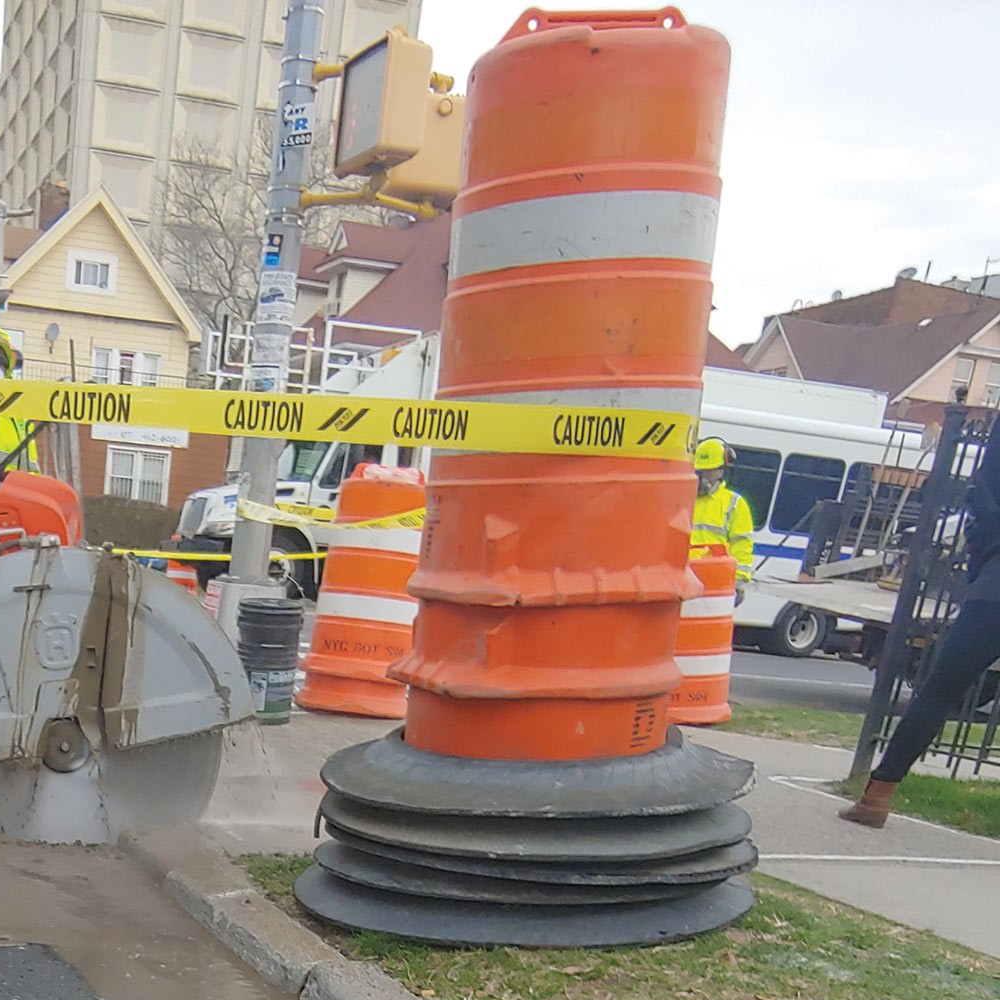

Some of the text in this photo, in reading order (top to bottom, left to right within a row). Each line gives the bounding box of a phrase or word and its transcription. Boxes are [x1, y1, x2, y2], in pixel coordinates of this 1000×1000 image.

[48, 390, 131, 423] CAUTION
[224, 399, 303, 433] CAUTION
[392, 407, 469, 441] CAUTION
[552, 414, 625, 447] CAUTION
